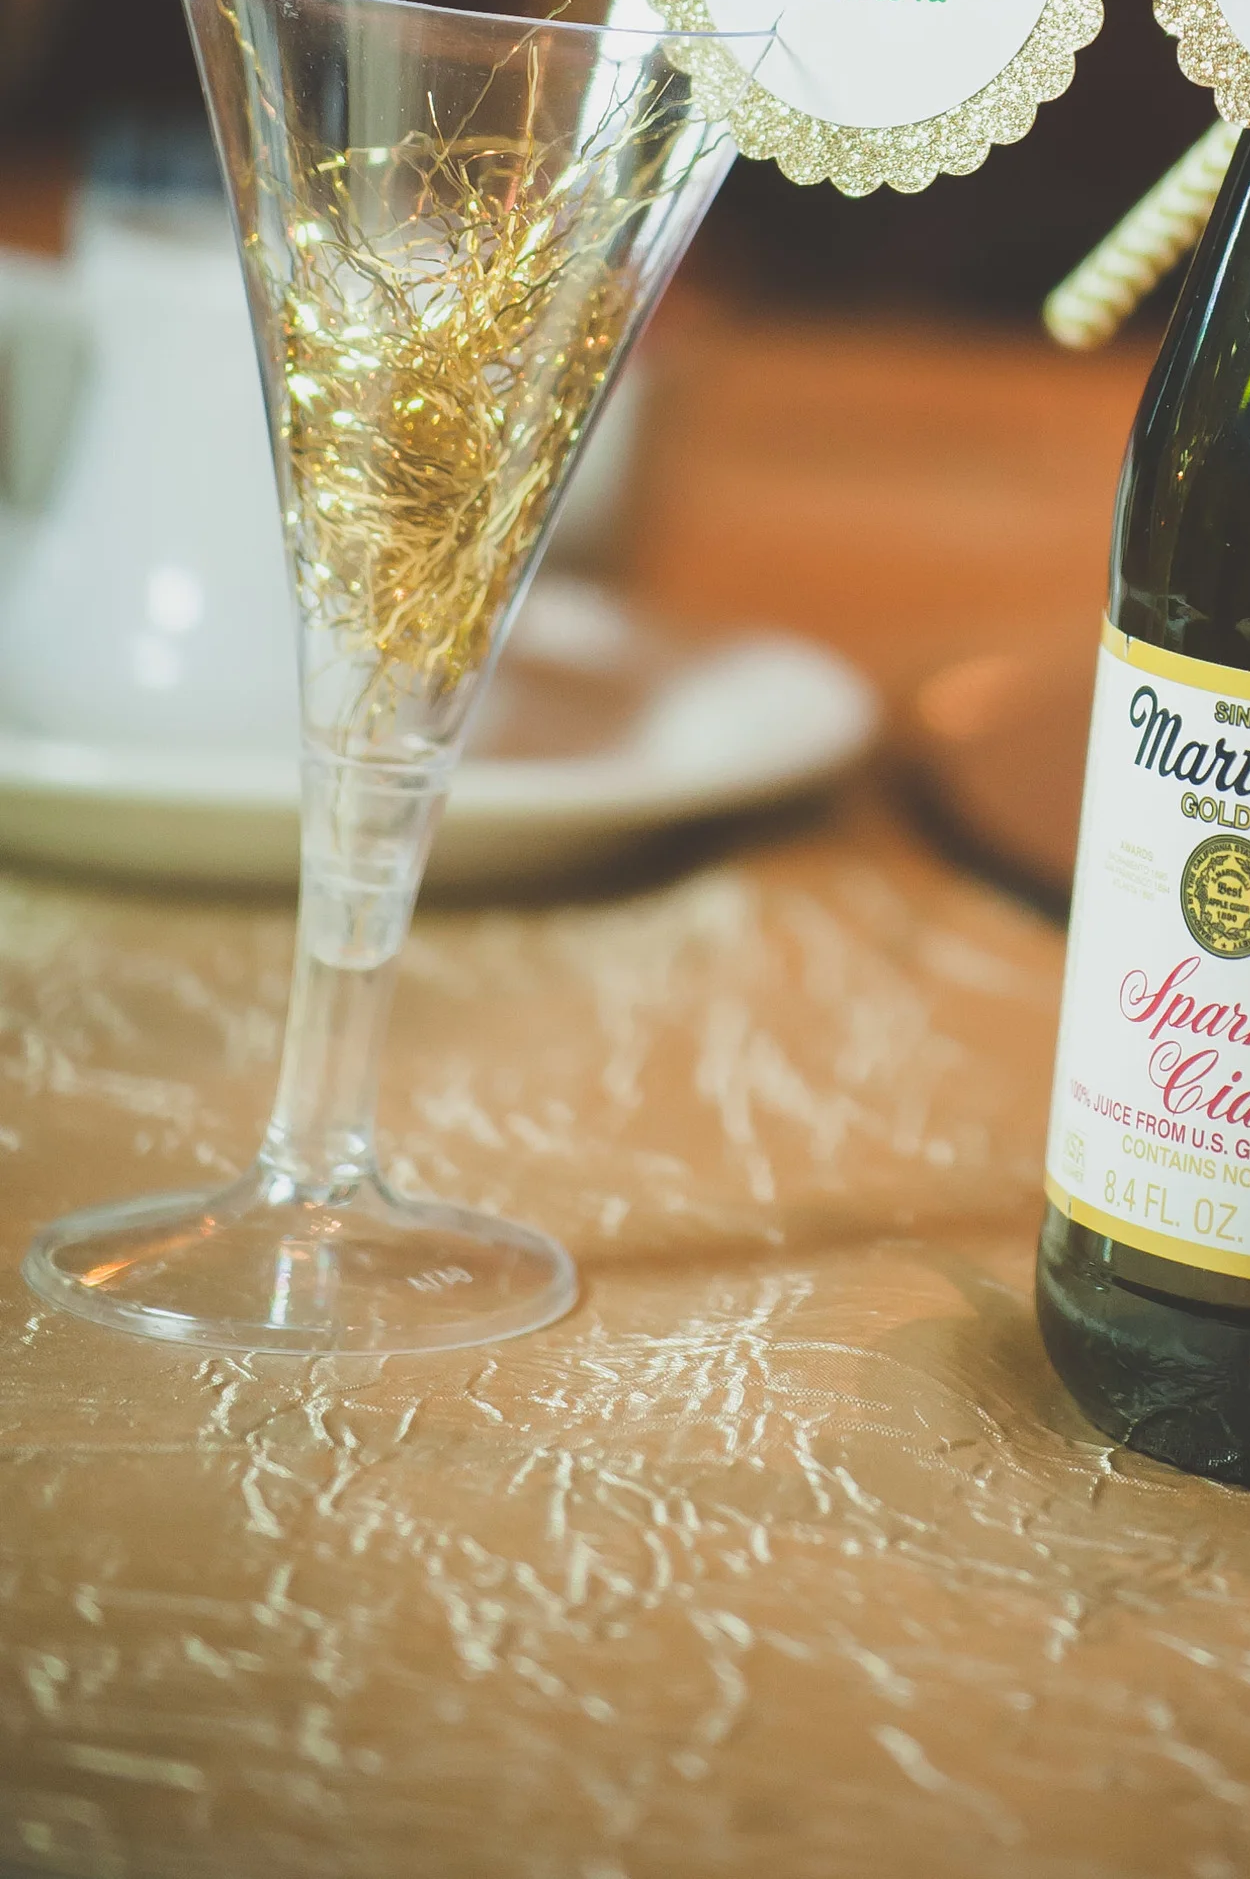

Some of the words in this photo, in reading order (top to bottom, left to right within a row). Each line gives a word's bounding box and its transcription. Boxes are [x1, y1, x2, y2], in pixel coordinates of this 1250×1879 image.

[1217, 881, 1242, 898] Best
[1094, 1094, 1132, 1126] JUICE
[1136, 1111, 1186, 1144] FROM
[1192, 1128, 1228, 1155] U.S.
[1122, 1134, 1217, 1180] CONTAINS
[1104, 1169, 1136, 1212] 8.4
[1144, 1183, 1180, 1227] FL.
[1194, 1198, 1243, 1243] OZ.
